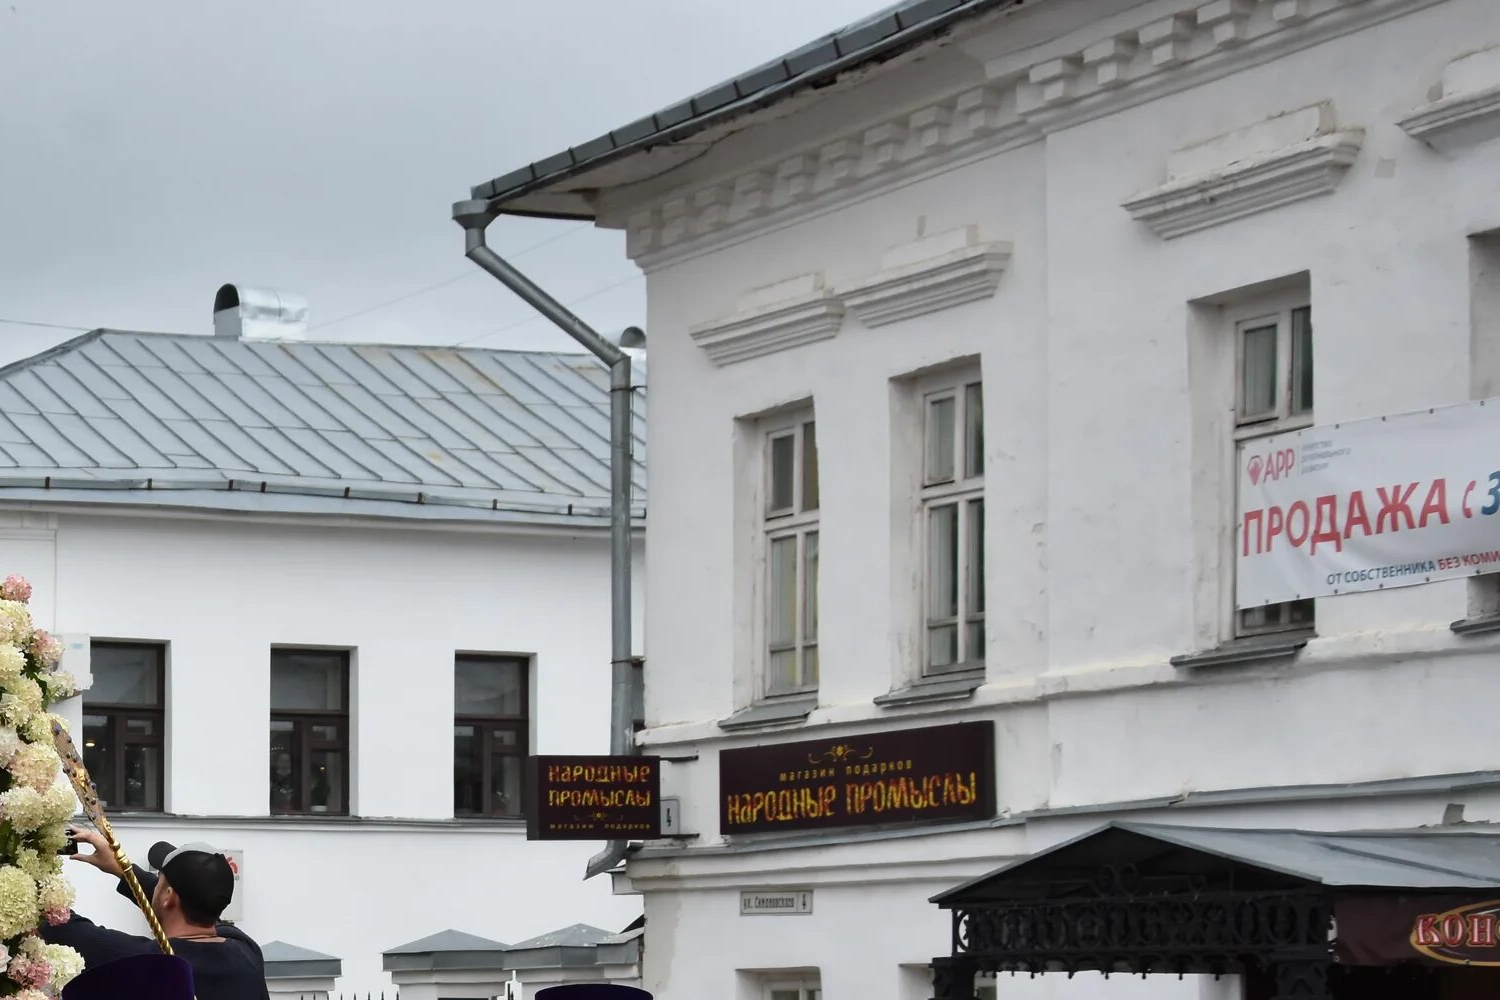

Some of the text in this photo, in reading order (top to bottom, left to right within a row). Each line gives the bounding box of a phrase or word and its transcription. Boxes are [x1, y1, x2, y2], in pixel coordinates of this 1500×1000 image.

[1243, 477, 1451, 557] ПРОДАЖА
[1326, 570, 1342, 585] ОТ
[1344, 560, 1437, 584] СОБСТВЕННИКА
[1438, 556, 1461, 571] БЕЗ
[779, 758, 913, 782] магазин подарков
[1417, 913, 1500, 947] КОН
